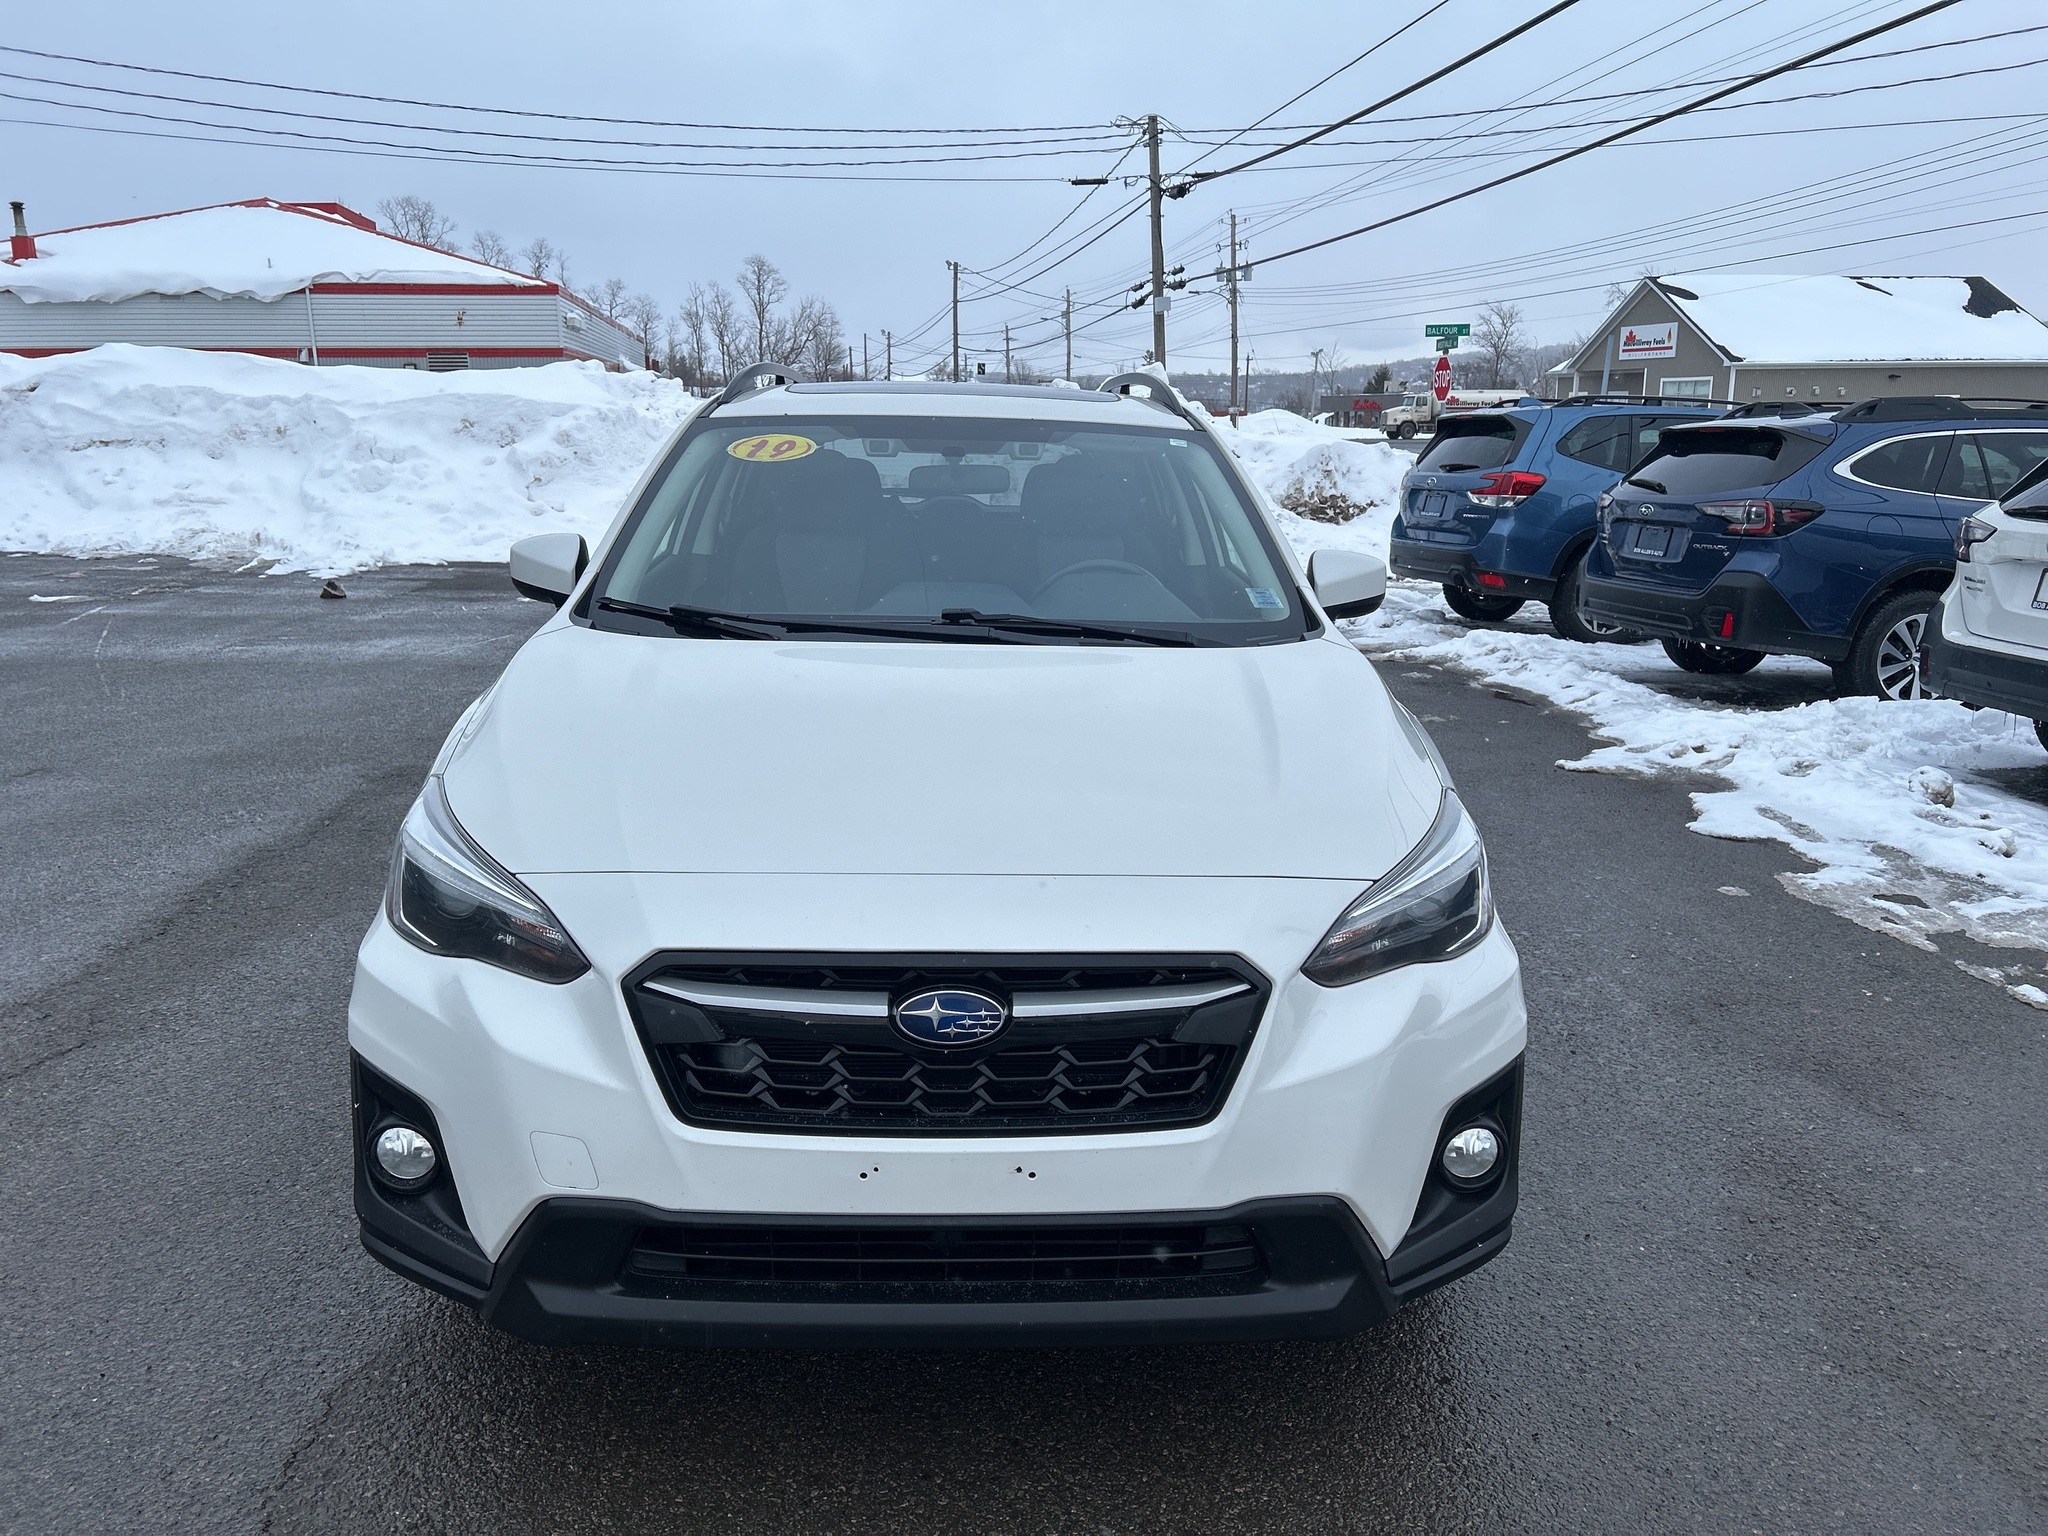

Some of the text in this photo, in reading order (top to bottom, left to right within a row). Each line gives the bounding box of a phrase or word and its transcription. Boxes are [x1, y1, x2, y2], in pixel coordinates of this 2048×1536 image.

[1426, 327, 1458, 335] BALFOUR
[1653, 337, 1665, 345] Fuels
[1434, 370, 1450, 388] STOP
[746, 439, 797, 458] 19
[1692, 543, 1728, 551] OUTBACK
[2033, 601, 2046, 609] BOB
